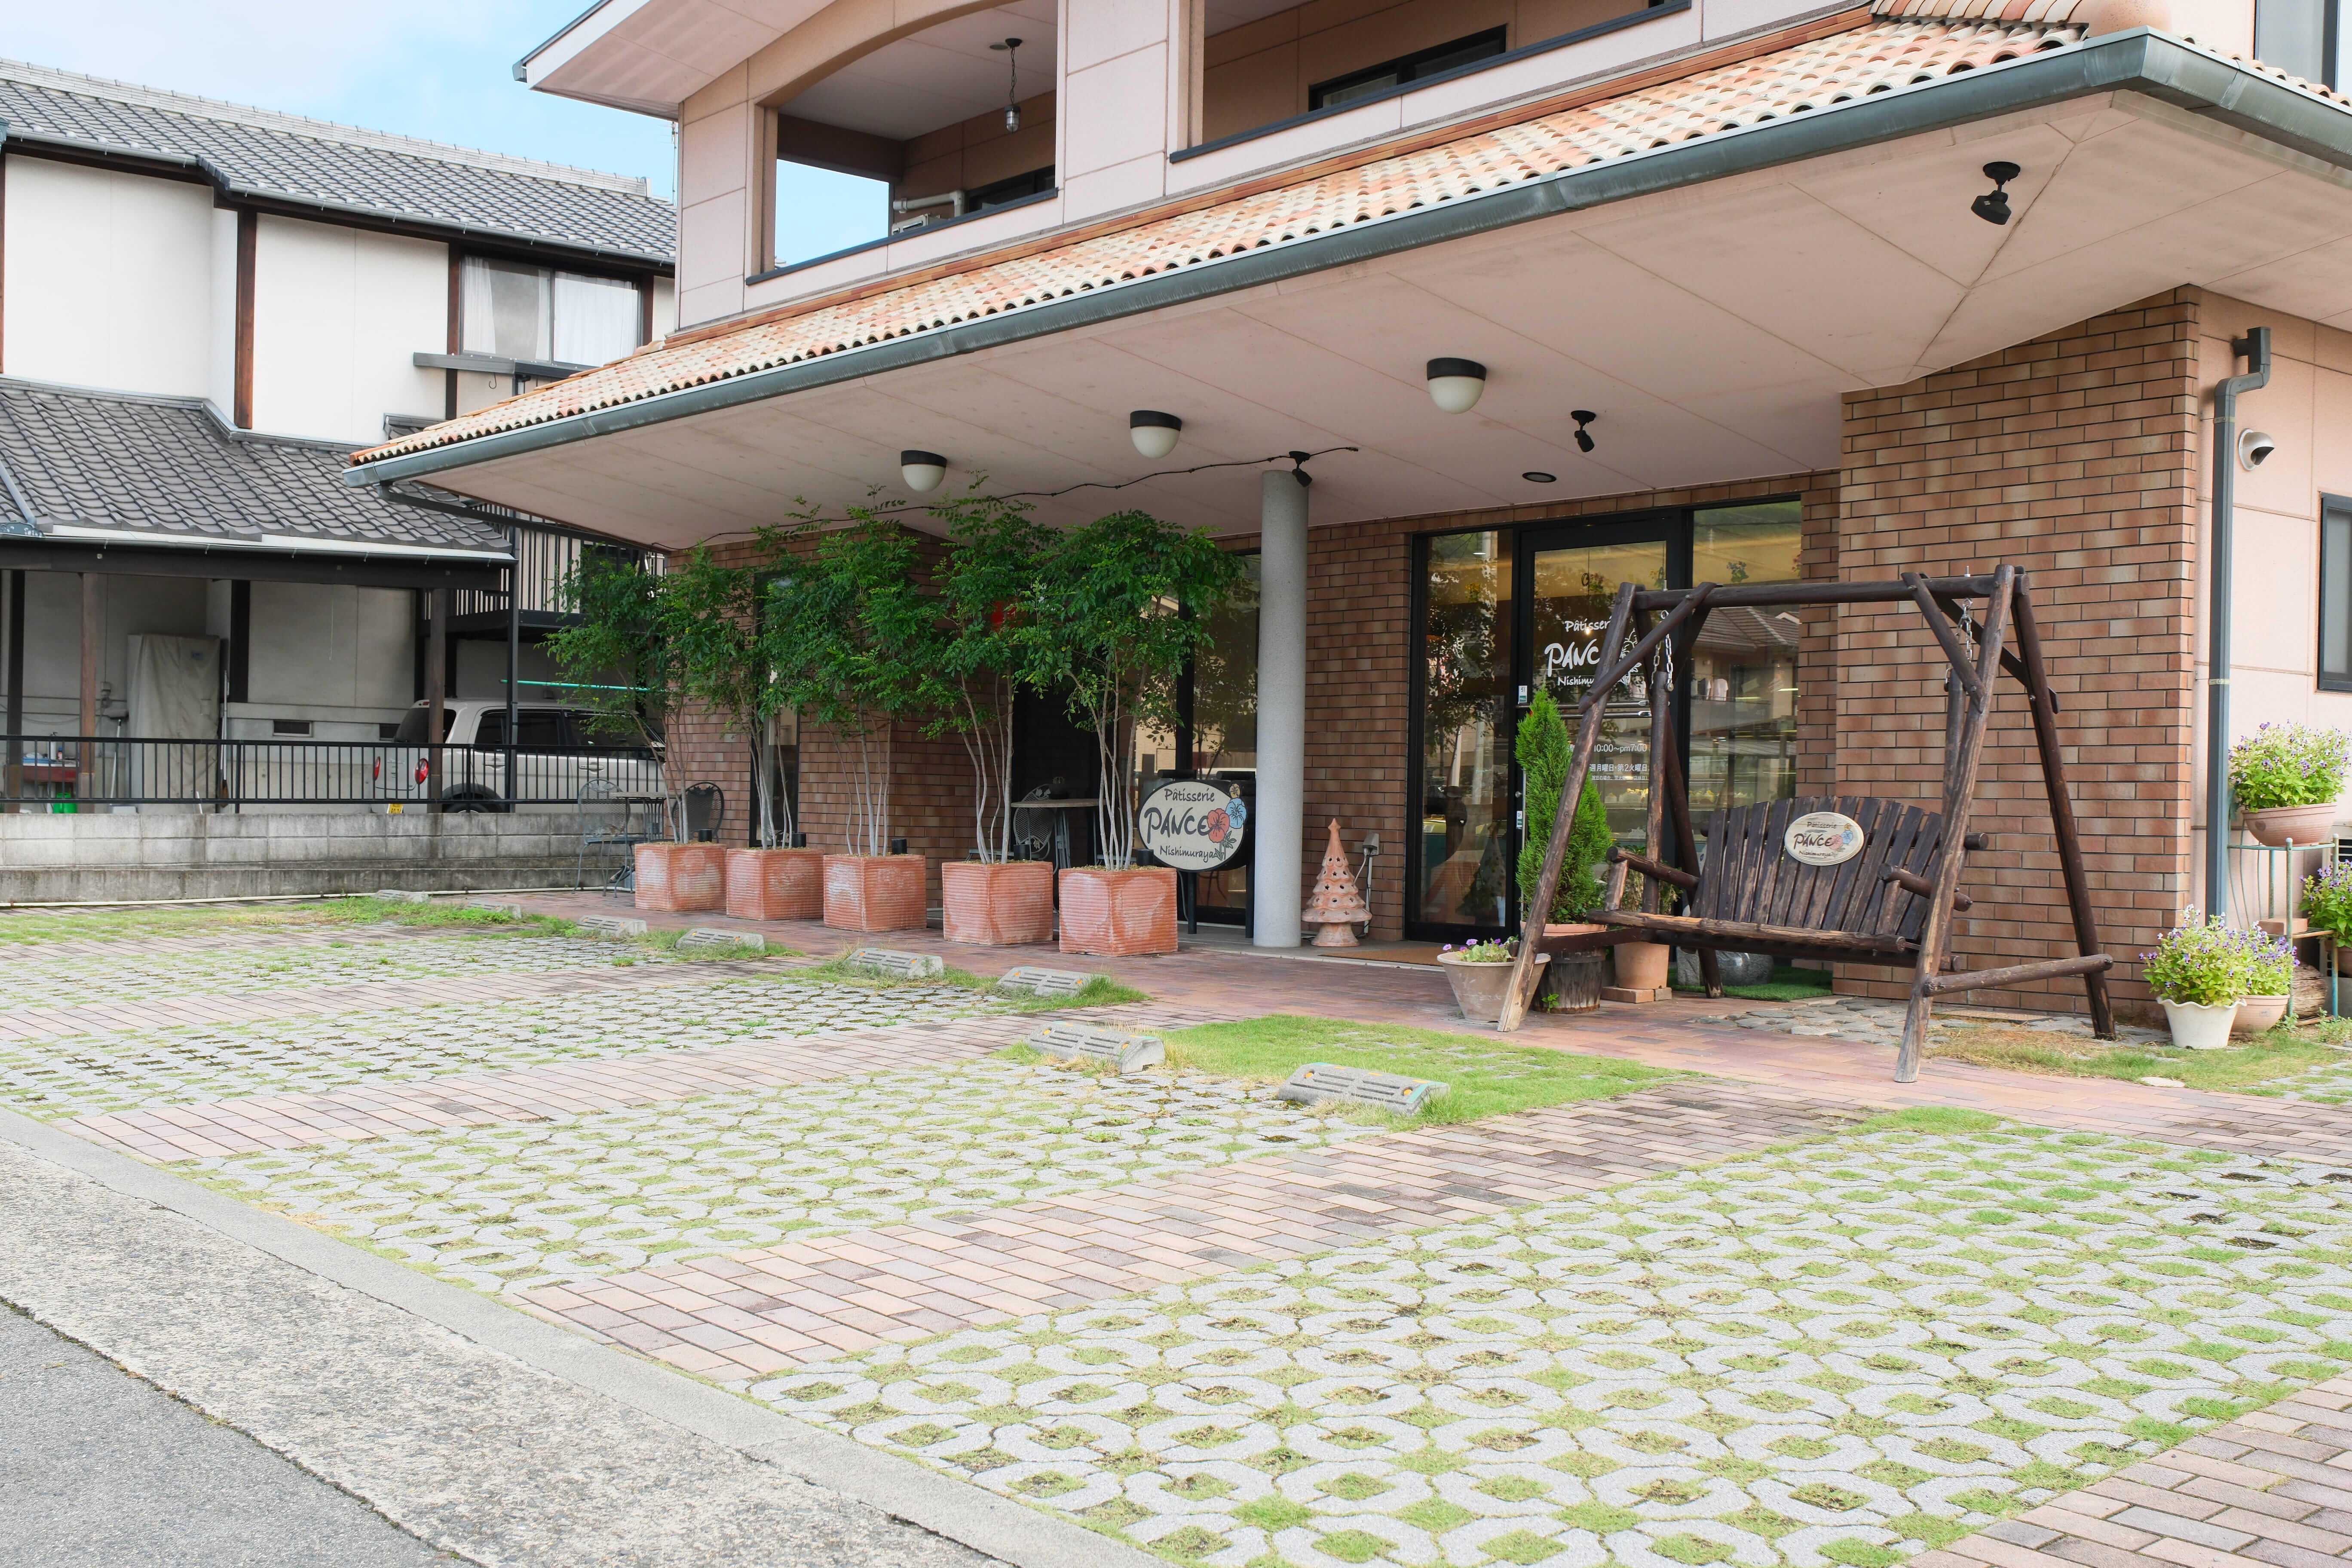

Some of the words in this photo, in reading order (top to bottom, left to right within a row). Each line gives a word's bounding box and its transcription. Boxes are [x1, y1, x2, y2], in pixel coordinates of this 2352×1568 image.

[1565, 616, 1612, 632] Pâtisser
[1544, 639, 1601, 677] PANC
[1558, 675, 1595, 686] Nishimu
[1164, 787, 1215, 802] Pâtisserie
[1144, 807, 1214, 844] PANCE
[1160, 845, 1215, 863] Nishimuraya
